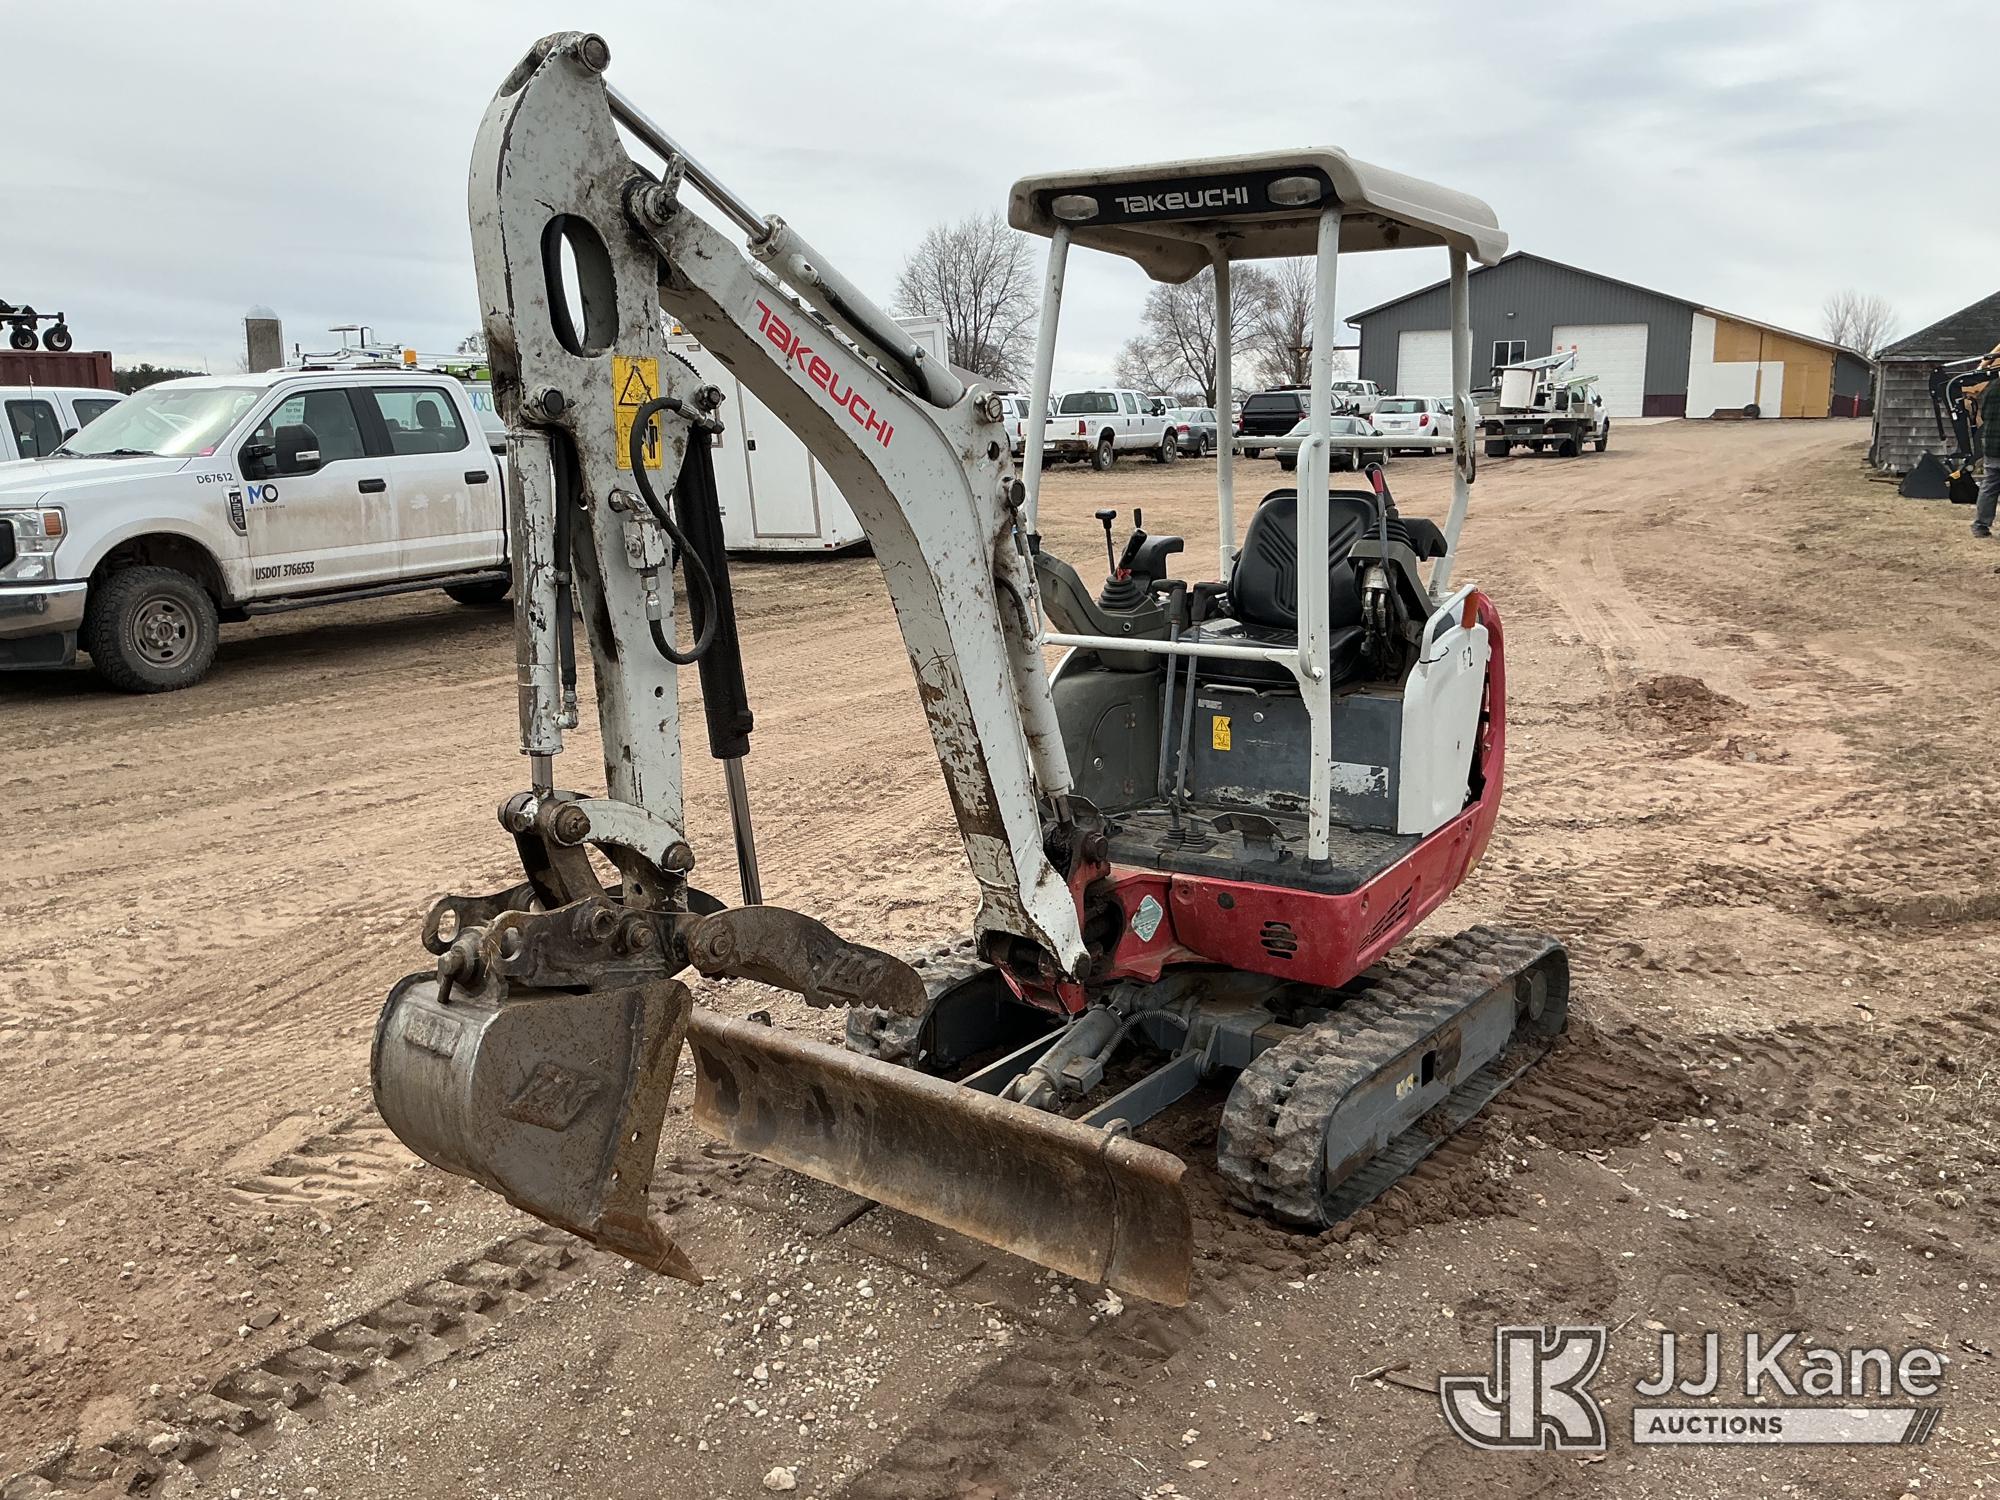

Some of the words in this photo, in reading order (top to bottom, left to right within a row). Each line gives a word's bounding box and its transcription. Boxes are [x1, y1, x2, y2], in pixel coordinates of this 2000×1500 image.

[1115, 187, 1249, 214] TAKEUCHI
[756, 299, 894, 448] TAKEUCHI
[196, 472, 234, 484] D67612
[247, 484, 279, 504] MO
[255, 565, 281, 580] USDOT
[283, 561, 315, 577] 3766553
